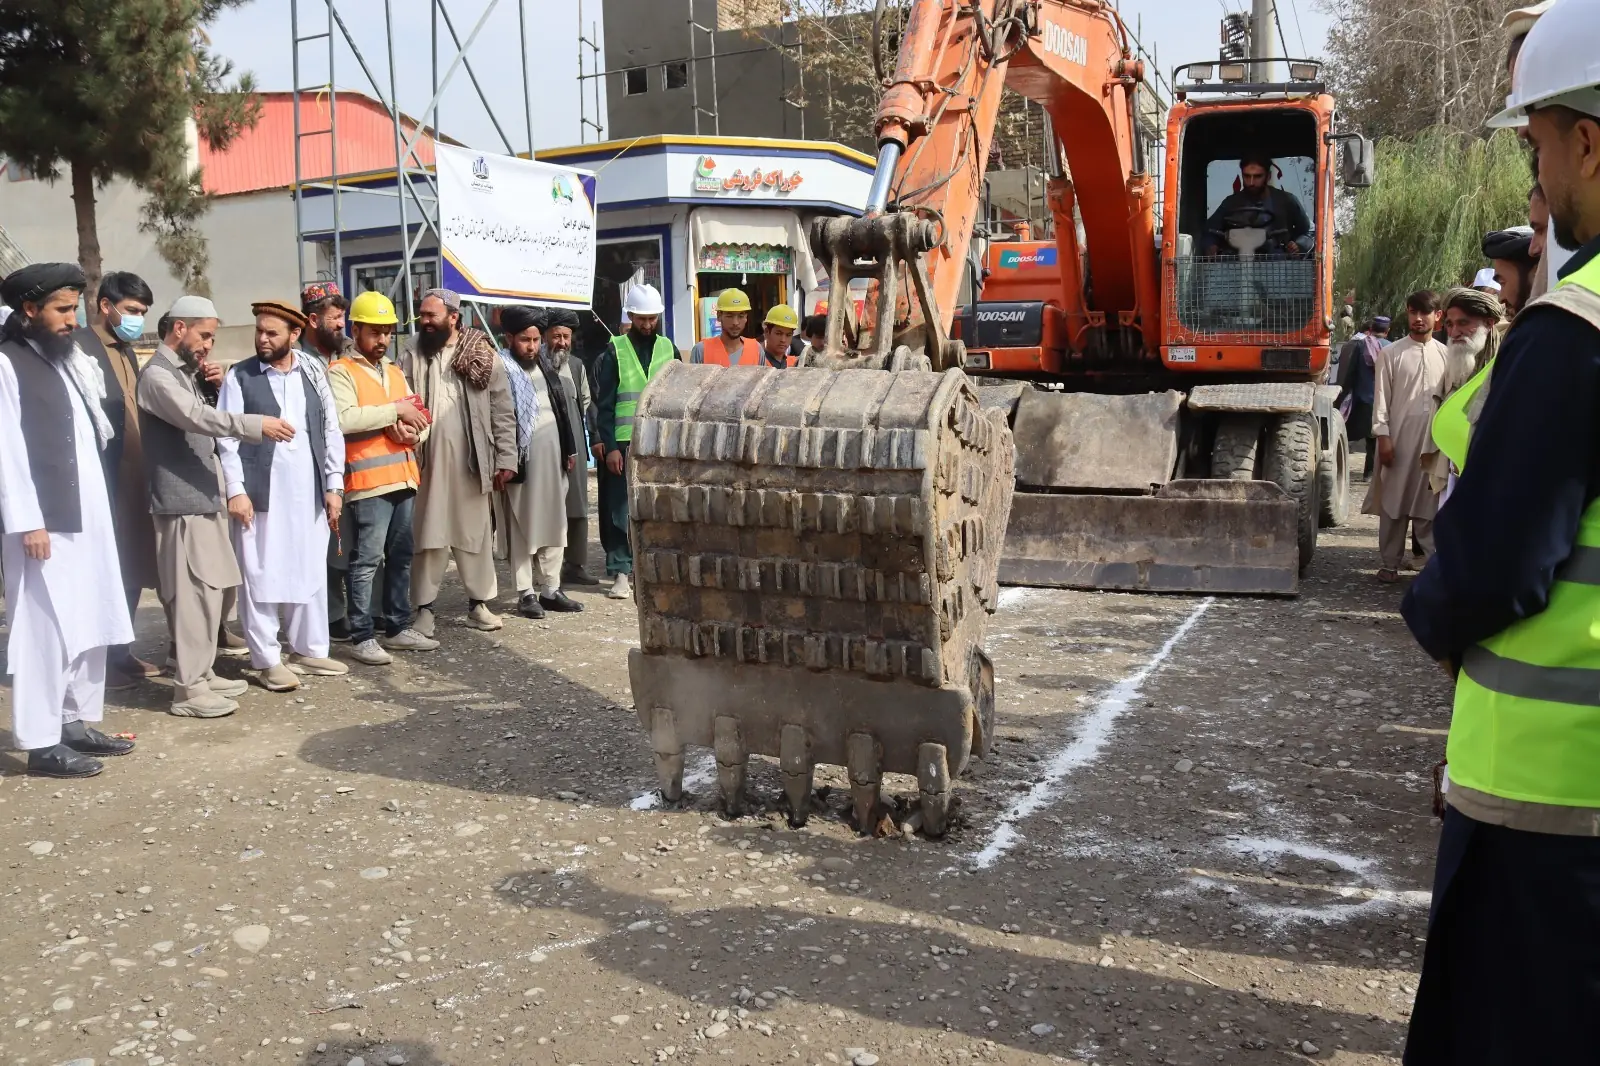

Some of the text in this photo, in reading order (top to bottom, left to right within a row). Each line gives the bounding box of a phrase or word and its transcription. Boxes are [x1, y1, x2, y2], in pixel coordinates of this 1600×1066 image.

[1044, 20, 1088, 67] DOOSAN
[722, 166, 763, 191] فروشی
[764, 169, 804, 192] خوراکه
[1007, 255, 1045, 264] DOOSAN
